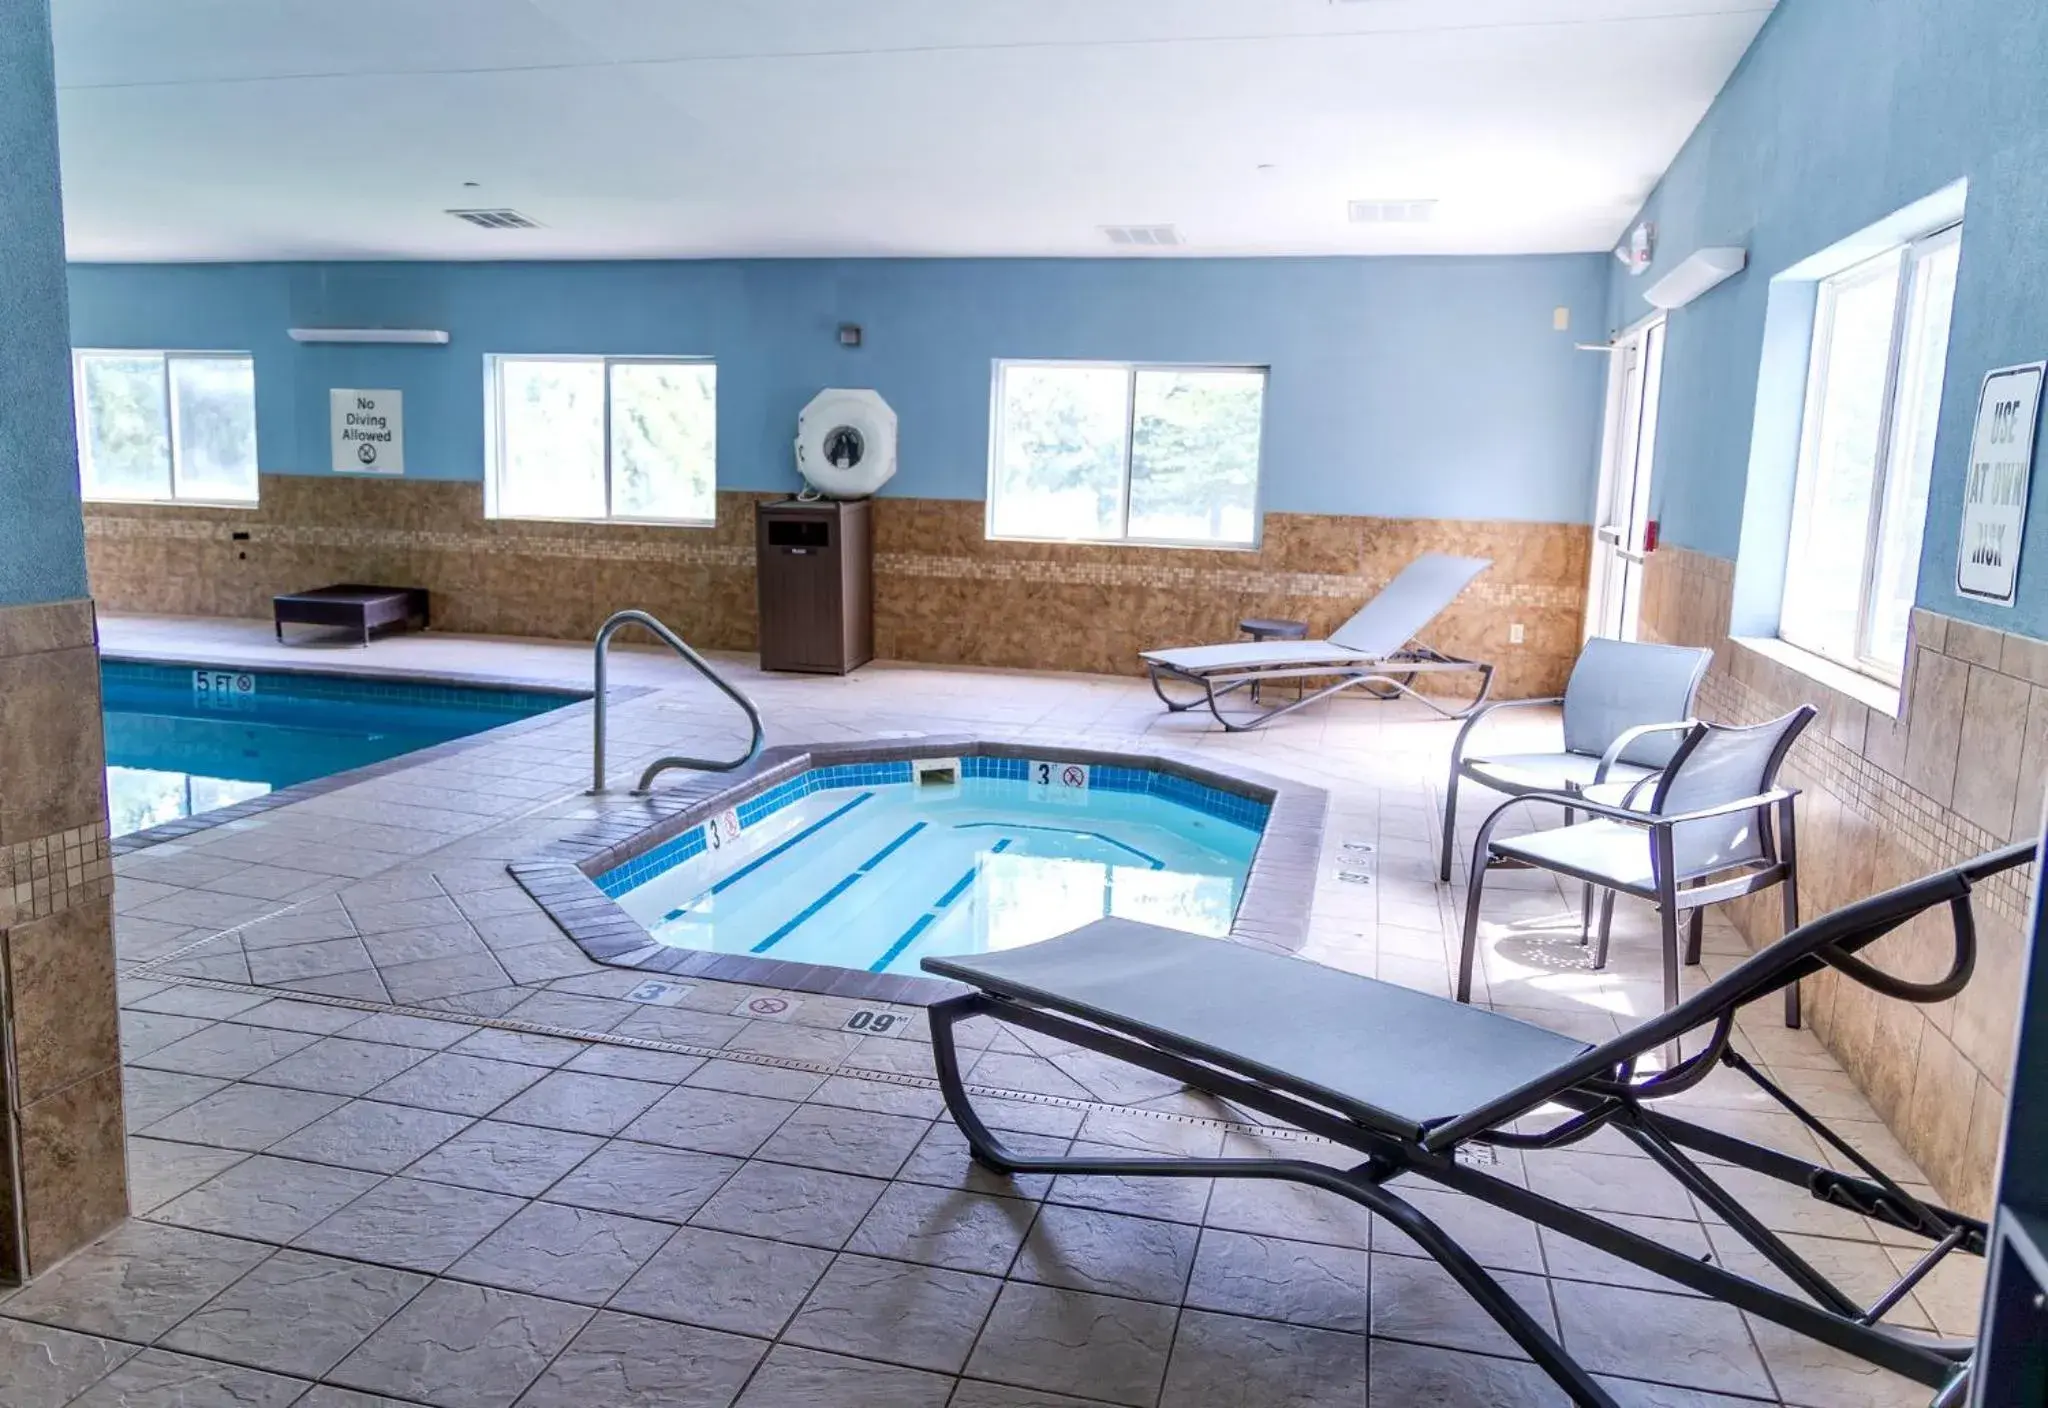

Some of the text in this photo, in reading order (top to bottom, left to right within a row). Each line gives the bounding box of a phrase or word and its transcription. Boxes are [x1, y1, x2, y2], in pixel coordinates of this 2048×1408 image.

[356, 397, 375, 410] No
[346, 412, 386, 429] Diving
[1991, 400, 2020, 444] USE
[342, 429, 392, 442] Allowed
[1969, 462, 2026, 506] AT OWN
[197, 671, 232, 693] 5 FT
[1038, 763, 1049, 785] 3
[711, 819, 720, 850] 3
[633, 984, 667, 1000] 3
[847, 1011, 896, 1032] 09
